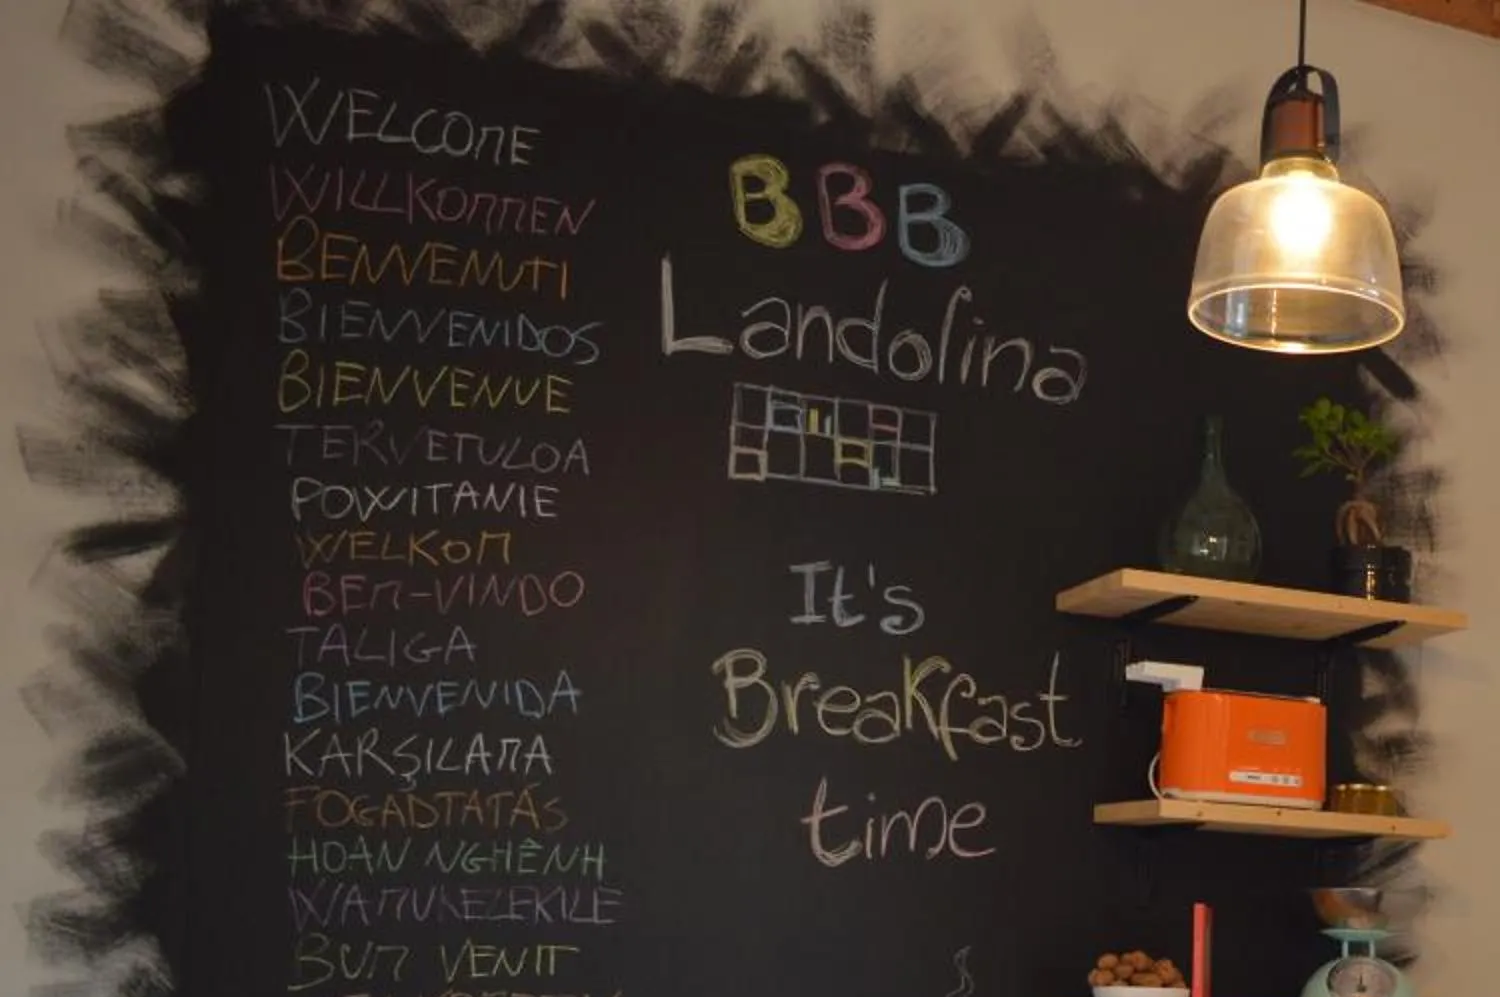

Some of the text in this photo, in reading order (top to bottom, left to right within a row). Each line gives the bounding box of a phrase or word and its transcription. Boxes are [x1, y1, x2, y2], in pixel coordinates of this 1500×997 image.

[265, 77, 541, 165] WELCOME
[269, 163, 597, 235] WILLKOMMEN
[277, 215, 568, 301] BENVENUTI
[278, 287, 605, 365] BIENVENIDOS
[661, 249, 1089, 405] Landolina
[278, 349, 574, 413] BIENVENUE
[273, 420, 590, 476] TERVETULOA
[291, 477, 560, 521] POWITANIE
[296, 529, 511, 569] WELKOM
[303, 570, 586, 617] BEM-VINDO
[789, 560, 925, 635] It's
[285, 623, 477, 667] TALIGA
[293, 669, 583, 724] BIENVENIDA
[712, 648, 1083, 761] Breakfast
[802, 777, 997, 867] time
[288, 834, 412, 876] HOAN
[441, 938, 581, 983] VENIT
